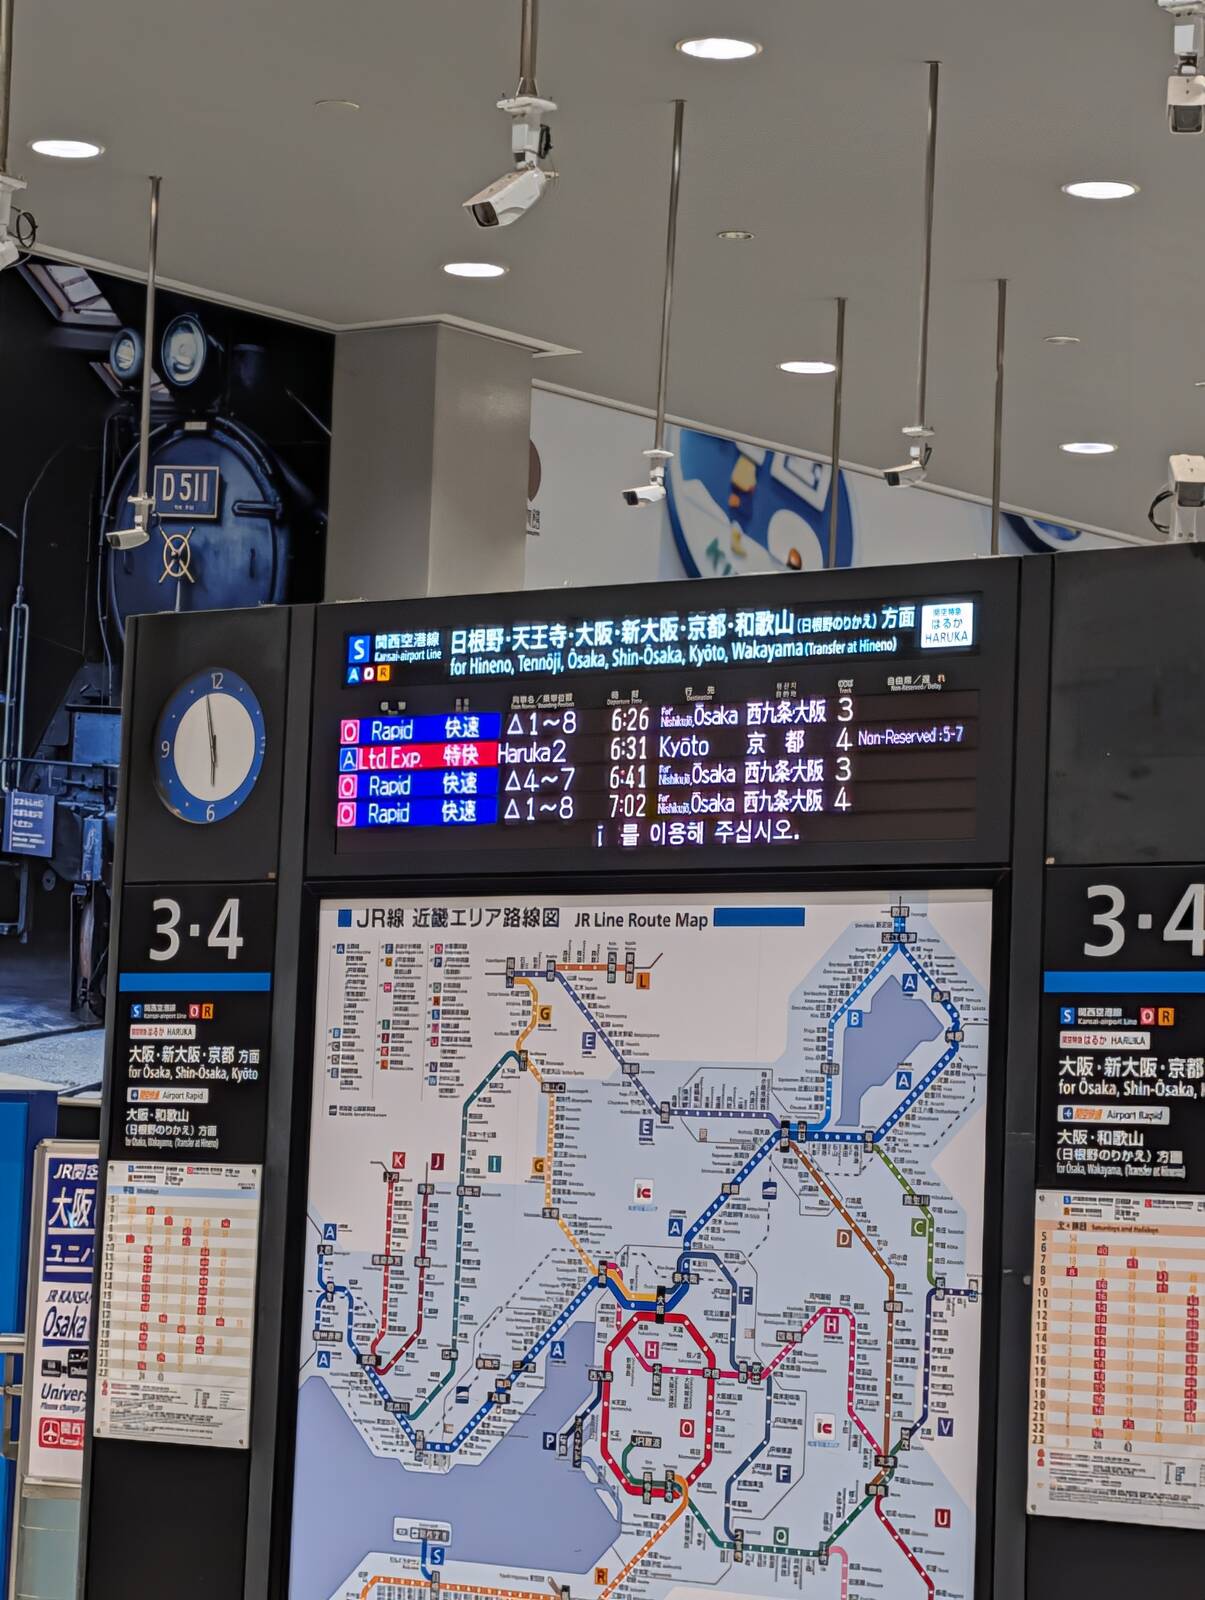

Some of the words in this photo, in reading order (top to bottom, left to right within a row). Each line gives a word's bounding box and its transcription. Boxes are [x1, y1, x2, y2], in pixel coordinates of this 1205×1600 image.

[882, 606, 915, 630] 方面
[931, 618, 963, 629] はるか
[375, 631, 440, 649] 関西空港線
[925, 630, 968, 644] HARUKA
[426, 648, 442, 661] Line
[450, 659, 467, 677] for
[469, 657, 515, 675] Hineno,
[567, 648, 609, 671] Ōsaka,
[689, 642, 729, 667] Kyōto,
[731, 639, 803, 663] Wakayama
[805, 640, 847, 657] (Transfer
[847, 641, 858, 653] at
[859, 636, 897, 653] Hineno)
[211, 672, 224, 689] 12
[661, 706, 673, 716] For
[838, 697, 853, 722] 3
[372, 719, 413, 742] Rapid
[445, 716, 480, 738] 快速
[612, 706, 649, 731] 6:26
[161, 740, 170, 758] 9
[443, 744, 480, 767] 特快
[499, 742, 550, 764] Haruka
[552, 740, 567, 763] 2
[610, 734, 647, 760] 6:31
[660, 734, 709, 758] Kyōto
[836, 725, 853, 751] 4
[835, 756, 852, 781] 3
[369, 775, 411, 796] Rapid
[442, 772, 478, 795] 快速
[610, 764, 646, 790] 6:41
[658, 793, 670, 803] For
[834, 786, 852, 812] 4
[206, 804, 215, 822] 6
[368, 802, 410, 825] Rapid
[441, 800, 477, 823] 快速
[609, 794, 646, 818] 7:02
[620, 822, 640, 847] 를
[650, 820, 704, 846] 이용해
[714, 818, 800, 845] 주십시오.
[357, 908, 405, 928] JR線
[413, 907, 560, 929] 近畿エリア路線図
[575, 911, 591, 929] JR
[594, 911, 624, 928] Line
[627, 911, 671, 929] Route
[675, 911, 708, 931] Map
[167, 1027, 192, 1036] HARUKA
[238, 1049, 260, 1064] 方面
[128, 1066, 140, 1080] for
[231, 1066, 258, 1083] Kyōto
[1059, 1078, 1076, 1095] for
[163, 1091, 184, 1103] Airport
[186, 1091, 203, 1102] Rapid
[1107, 1110, 1137, 1121] Airport
[198, 1126, 217, 1137] 方面
[48, 1186, 95, 1227] 大阪
[1042, 1232, 1047, 1242] 5
[1041, 1243, 1047, 1253] 6
[1041, 1255, 1047, 1264] 7
[1041, 1266, 1047, 1275] 8
[1040, 1277, 1046, 1287] 9
[1037, 1288, 1048, 1298] 10
[1038, 1299, 1048, 1309] 11
[1037, 1311, 1048, 1321] 12
[43, 1306, 87, 1338] Osaka
[1037, 1322, 1048, 1332] 13
[1036, 1333, 1048, 1343] 14
[1036, 1345, 1047, 1355] 15
[1036, 1356, 1047, 1366] 16
[1035, 1367, 1046, 1377] 17
[1035, 1378, 1046, 1388] 18
[1035, 1390, 1046, 1400] 19
[1034, 1401, 1046, 1411] 20
[1033, 1412, 1045, 1422] 21
[1033, 1424, 1045, 1434] 22
[1032, 1435, 1045, 1445] 23
